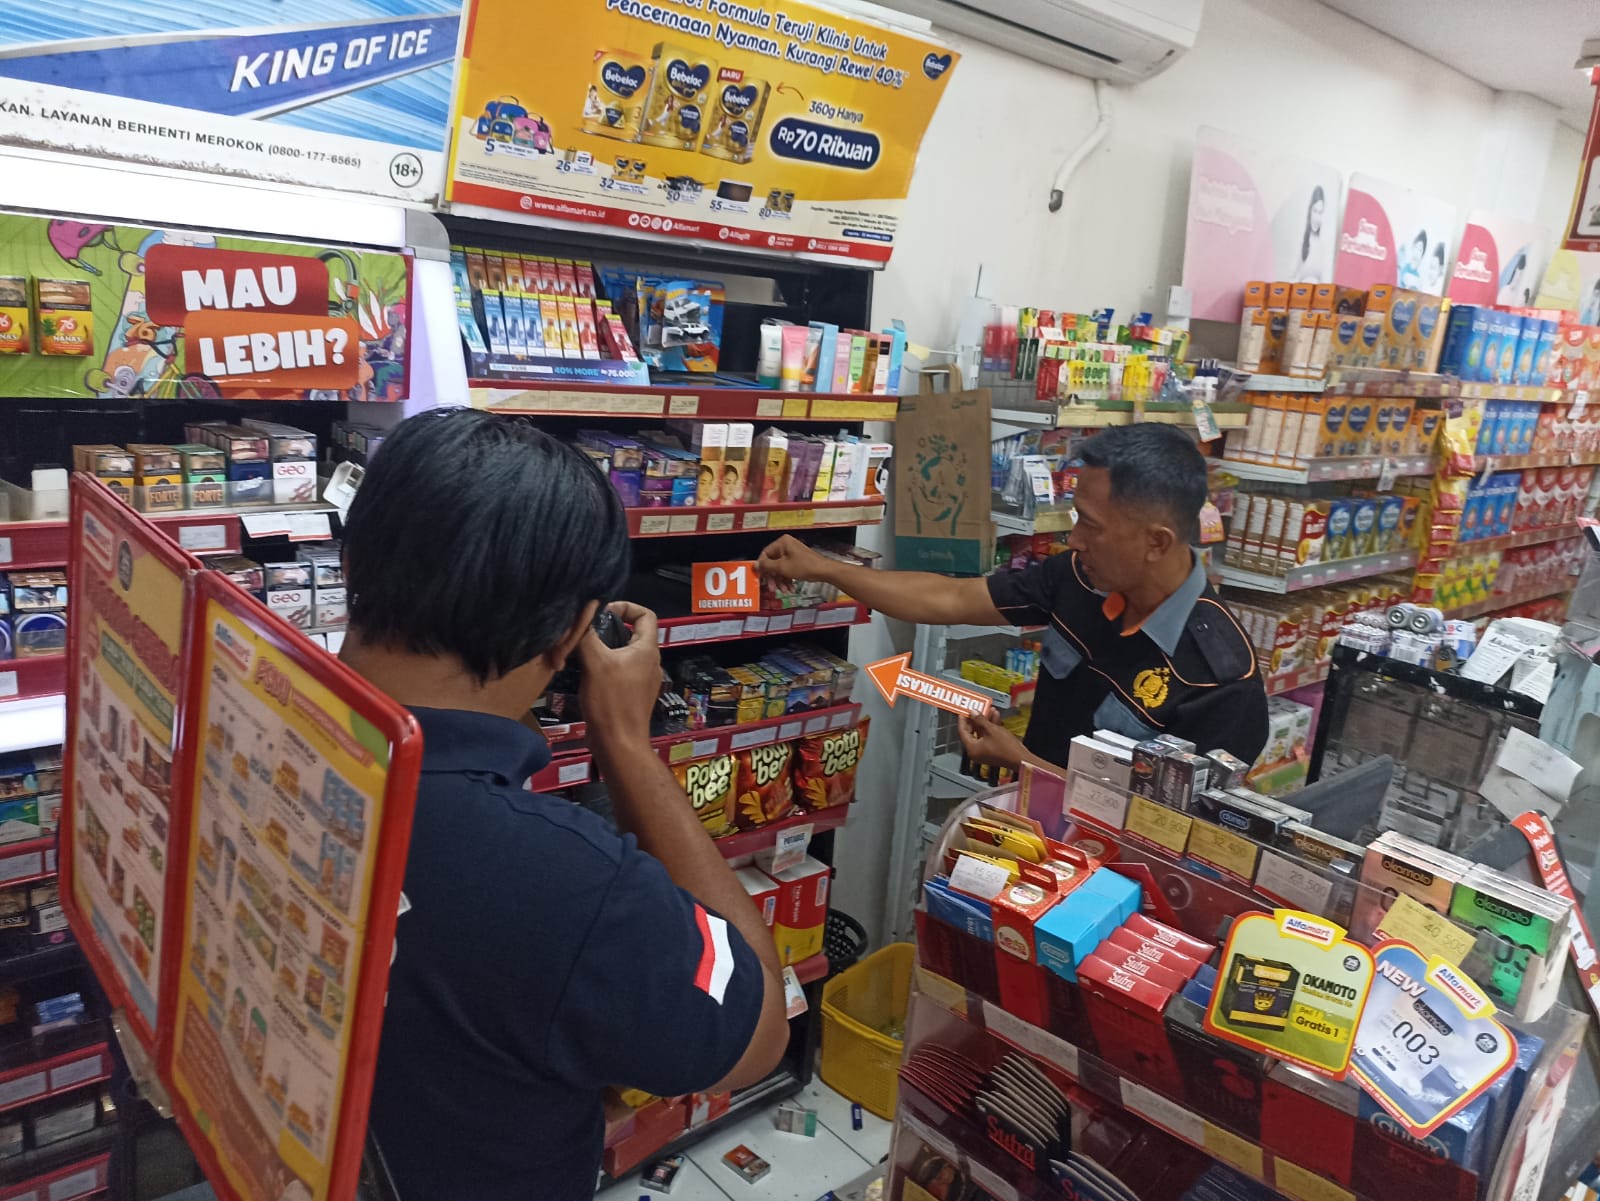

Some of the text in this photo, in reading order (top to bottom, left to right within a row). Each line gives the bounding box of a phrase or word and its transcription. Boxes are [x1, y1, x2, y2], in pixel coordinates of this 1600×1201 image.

[608, 0, 712, 36] Pencernaan
[716, 23, 781, 56] Nyaman.
[786, 43, 837, 72] Kurangi
[840, 57, 873, 79] Rewel
[708, 0, 888, 59] Formula Teruji Klinis Untuk
[229, 28, 432, 93] KING OF ICE
[604, 69, 639, 88] Bebelac
[670, 67, 702, 88] Bebelac
[720, 69, 742, 80] BARU
[724, 92, 750, 107] Bebelac
[809, 101, 864, 123] 360g Hanya
[41, 107, 112, 129] LAYANAN
[117, 119, 191, 141] BERHENTI
[195, 132, 264, 153] MEROKOK
[268, 144, 362, 169] (0800-177-6565)
[485, 138, 495, 153] 5
[778, 126, 873, 162] Rp70 Ribuan
[393, 162, 420, 178] 18+
[556, 160, 571, 172] 26
[600, 177, 615, 189] 32
[181, 266, 297, 312] MAU
[199, 328, 348, 377] LEBIH?
[704, 566, 748, 597] 01
[698, 598, 754, 609] IDENTIFIKASI
[822, 730, 859, 761] Pota
[824, 749, 857, 776] bee
[691, 776, 731, 810] bee
[1286, 918, 1331, 938] Alfamart
[1107, 970, 1136, 991] Sutra
[1303, 974, 1357, 1000] OKAMOTO
[1376, 960, 1427, 999] NEW
[1438, 967, 1482, 1008] Alfamart
[1296, 1015, 1331, 1035] Gratis
[1392, 1021, 1440, 1065] 003
